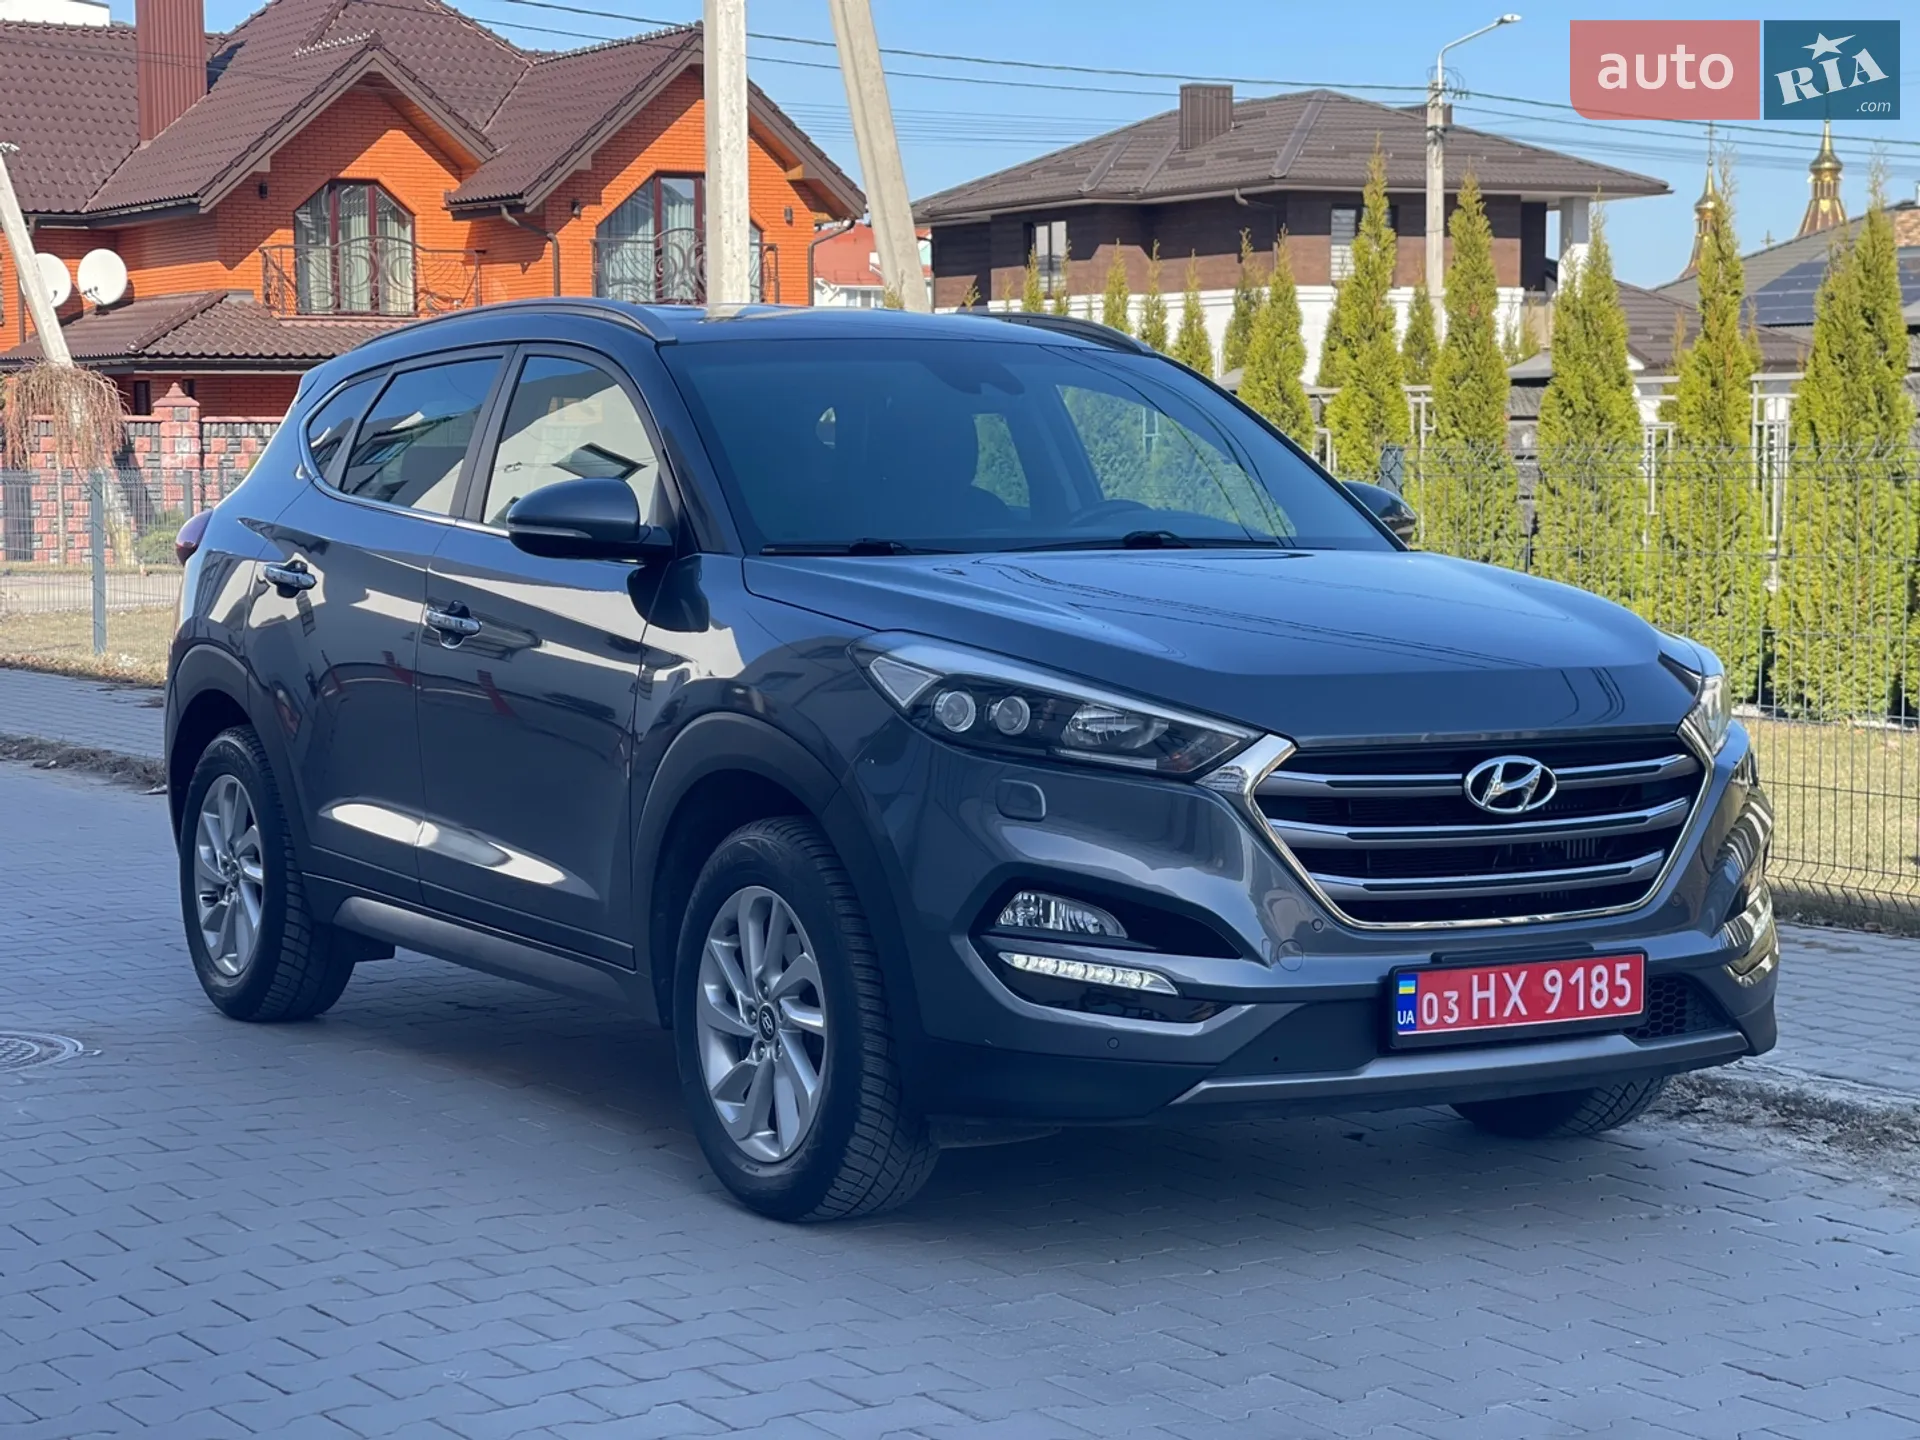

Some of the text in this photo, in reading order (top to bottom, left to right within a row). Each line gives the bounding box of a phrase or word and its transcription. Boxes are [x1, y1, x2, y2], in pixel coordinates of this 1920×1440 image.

[1422, 963, 1631, 1026] 03 HX 9185
[1397, 1010, 1415, 1025] UA
